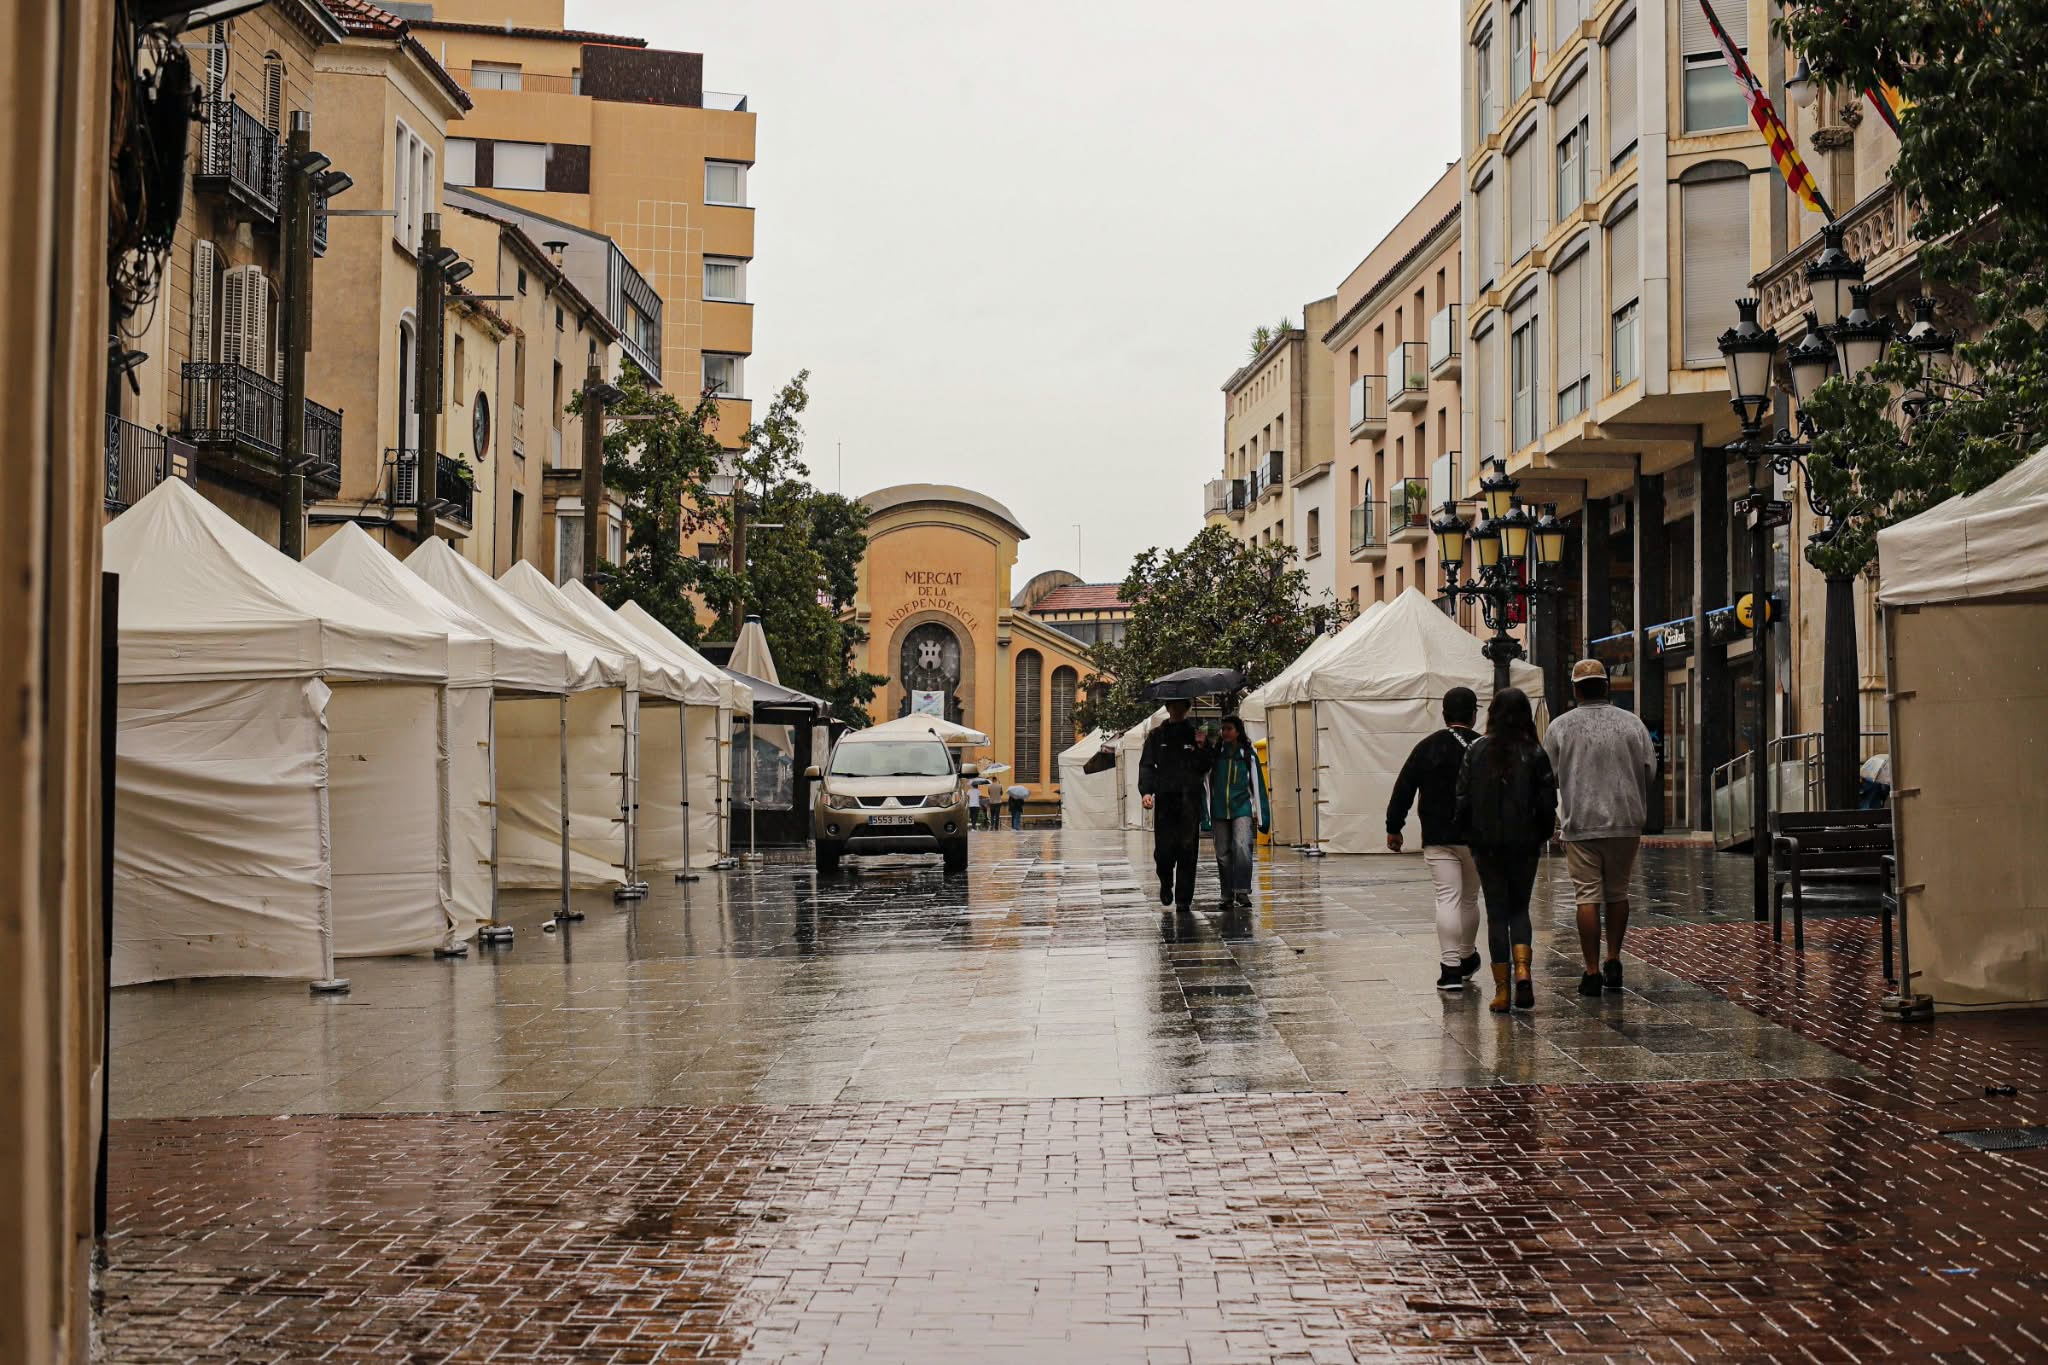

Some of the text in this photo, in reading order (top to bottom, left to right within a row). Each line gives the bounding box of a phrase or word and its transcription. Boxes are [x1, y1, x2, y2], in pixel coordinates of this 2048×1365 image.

[905, 571, 962, 585] MERCAT
[918, 586, 947, 596] DE LA
[885, 598, 978, 631] INDEPENDENCIA
